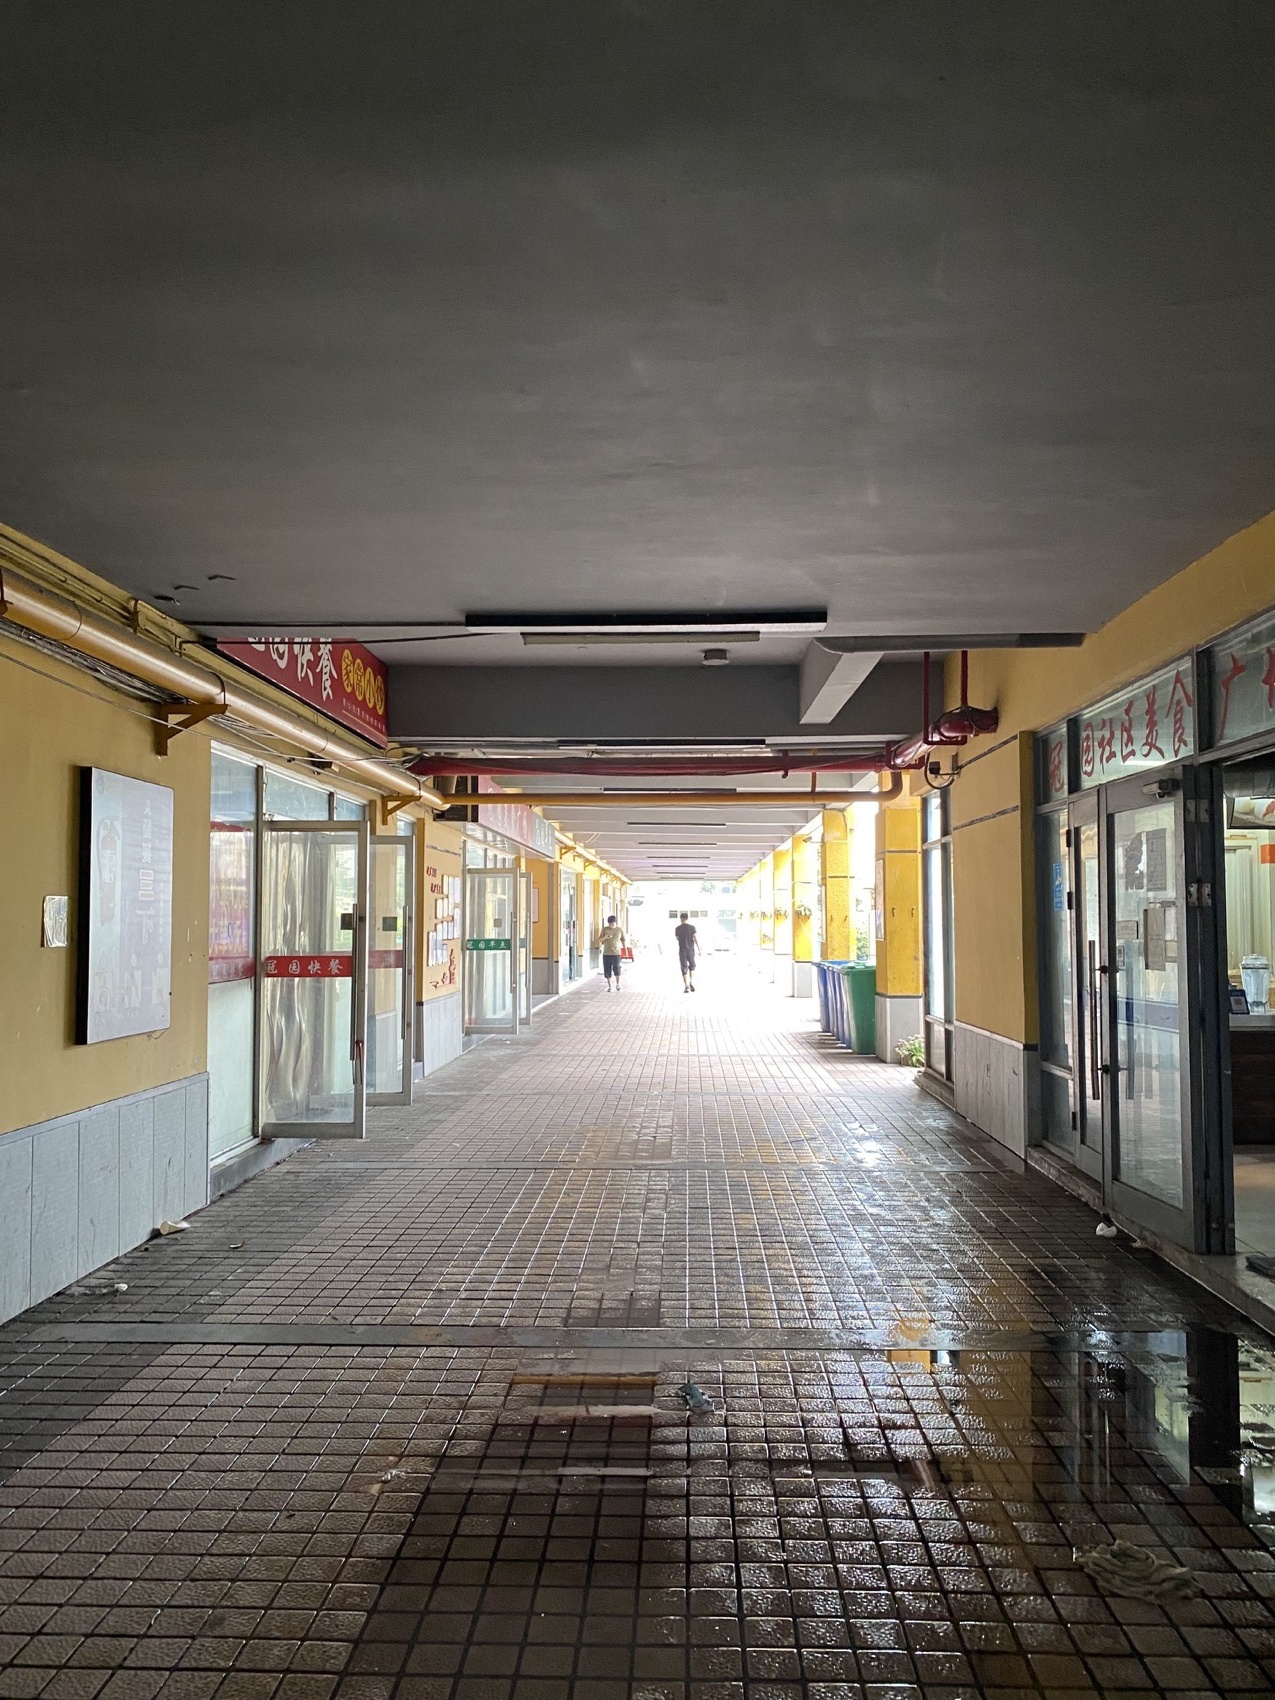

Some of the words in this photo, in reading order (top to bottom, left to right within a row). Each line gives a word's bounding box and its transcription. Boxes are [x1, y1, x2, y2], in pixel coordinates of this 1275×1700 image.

[247, 637, 338, 701] 快餐
[266, 958, 343, 975] 冠园快餐
